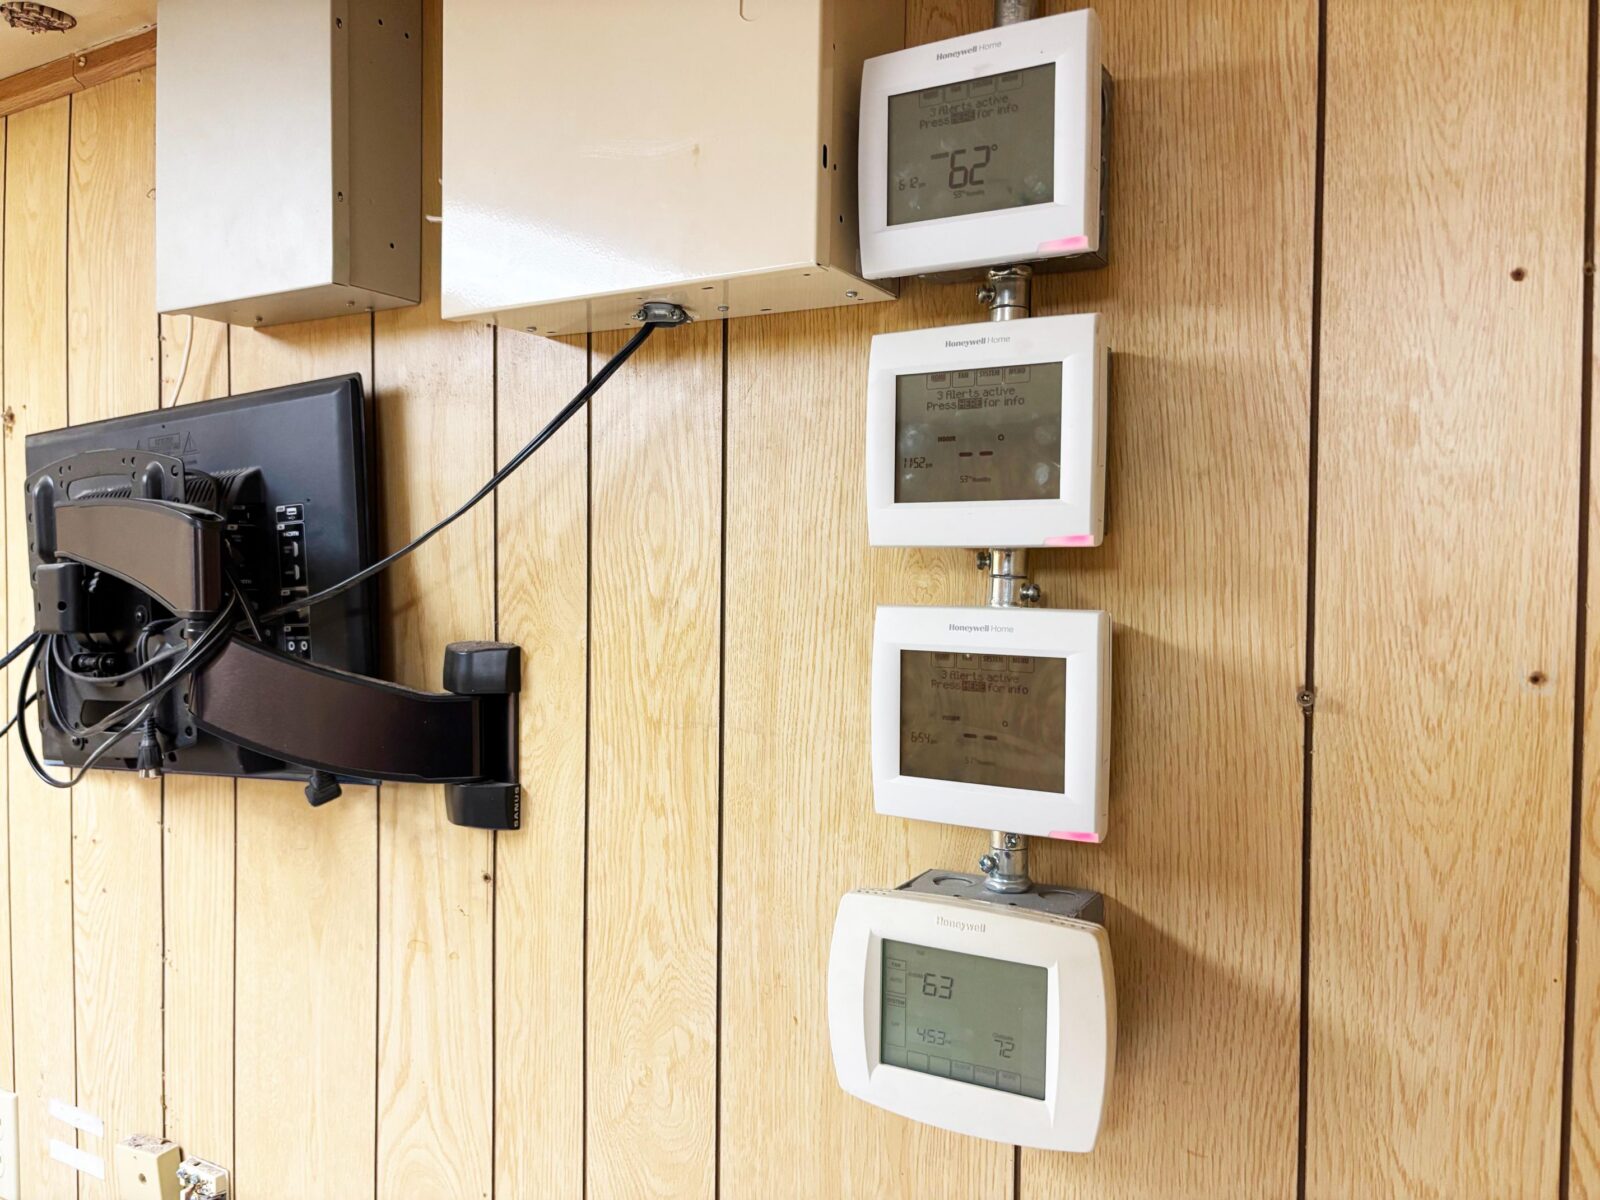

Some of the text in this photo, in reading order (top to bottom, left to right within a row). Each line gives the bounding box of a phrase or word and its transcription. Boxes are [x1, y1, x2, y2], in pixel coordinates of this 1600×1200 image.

[936, 41, 1002, 60] Honeywell Home
[938, 102, 972, 116] Alerts
[975, 95, 1009, 109] active
[919, 118, 950, 130] Press
[975, 108, 995, 119] for
[997, 103, 1019, 115] info
[945, 335, 1011, 348] Honeywell Home
[936, 386, 1016, 401] 3 Alerts active
[926, 401, 957, 412] Press
[983, 397, 1000, 408] for
[1003, 395, 1025, 407] info
[949, 623, 1014, 634] Honeywell Home
[941, 669, 948, 680] 3
[949, 670, 983, 681] Alerts
[930, 679, 961, 690] Press
[987, 683, 1004, 693] for
[1007, 685, 1029, 695] info
[936, 915, 986, 933] Honeywell
[922, 972, 954, 1000] 63
[994, 1039, 1015, 1059] 72
